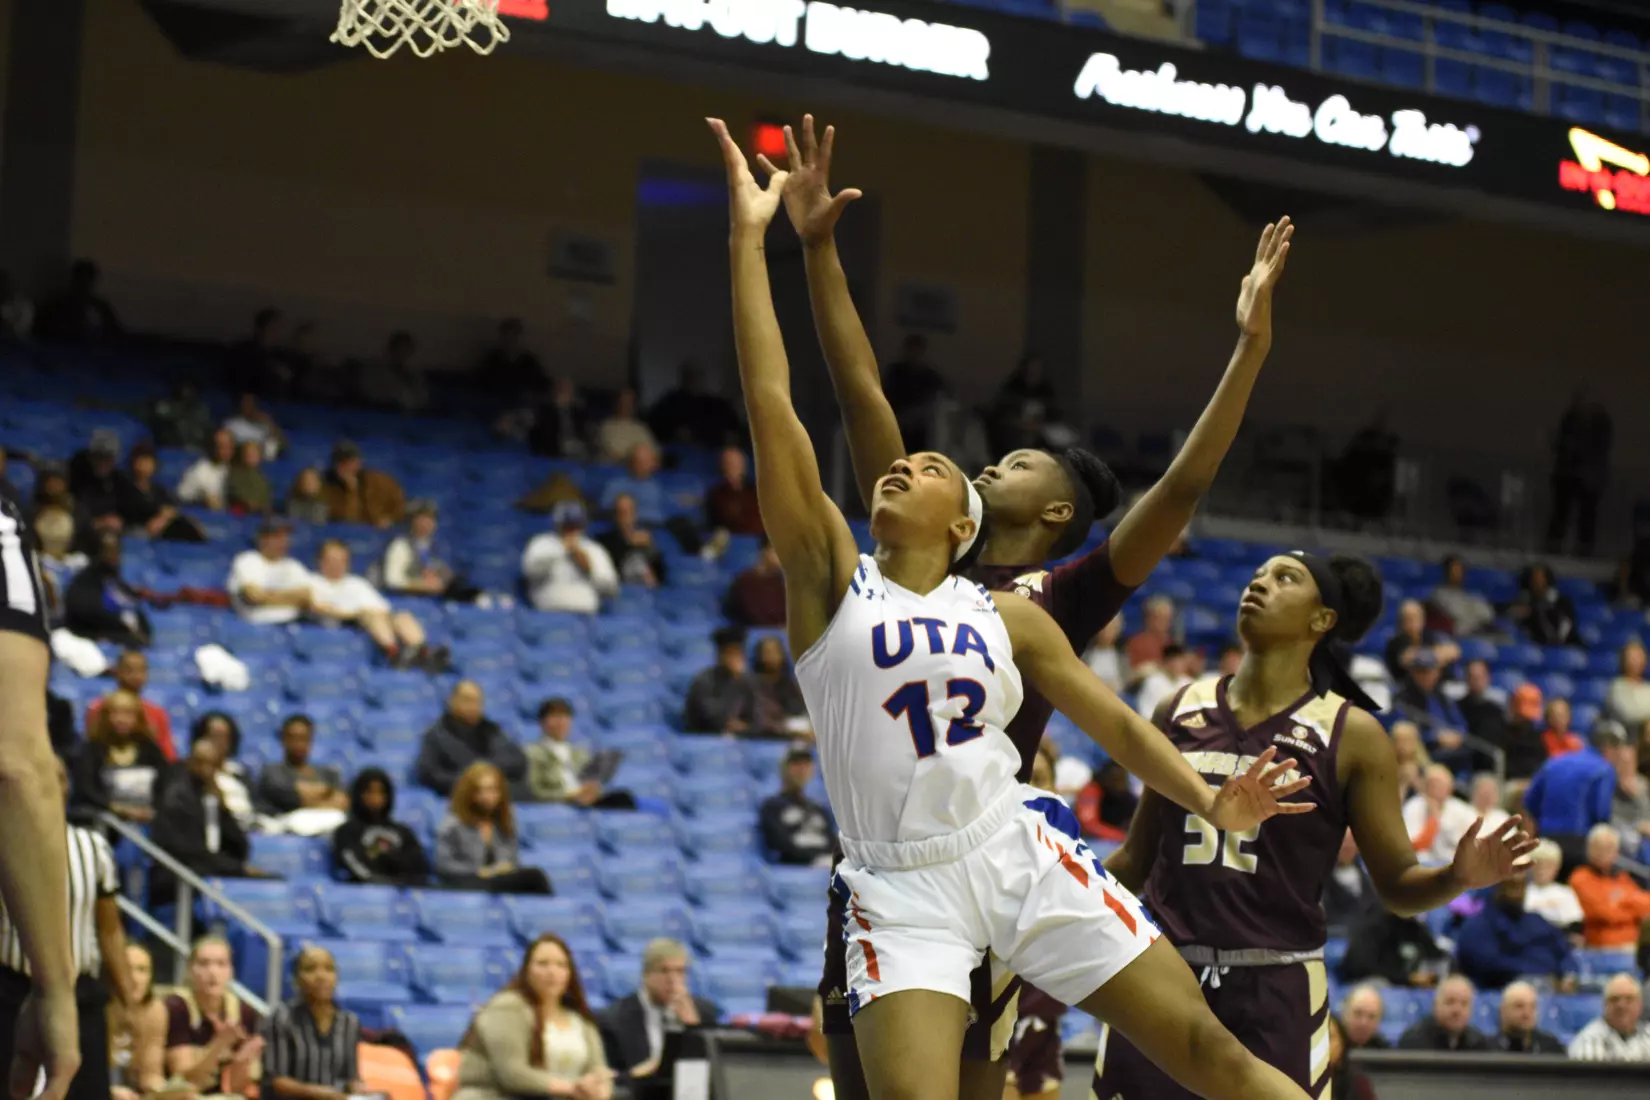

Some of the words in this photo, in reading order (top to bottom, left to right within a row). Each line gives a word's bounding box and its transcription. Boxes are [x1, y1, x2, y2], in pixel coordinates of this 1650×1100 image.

[872, 617, 995, 674] UTA
[881, 678, 986, 760] 12
[1273, 734, 1295, 745] SUN
[1295, 740, 1317, 754] BELT
